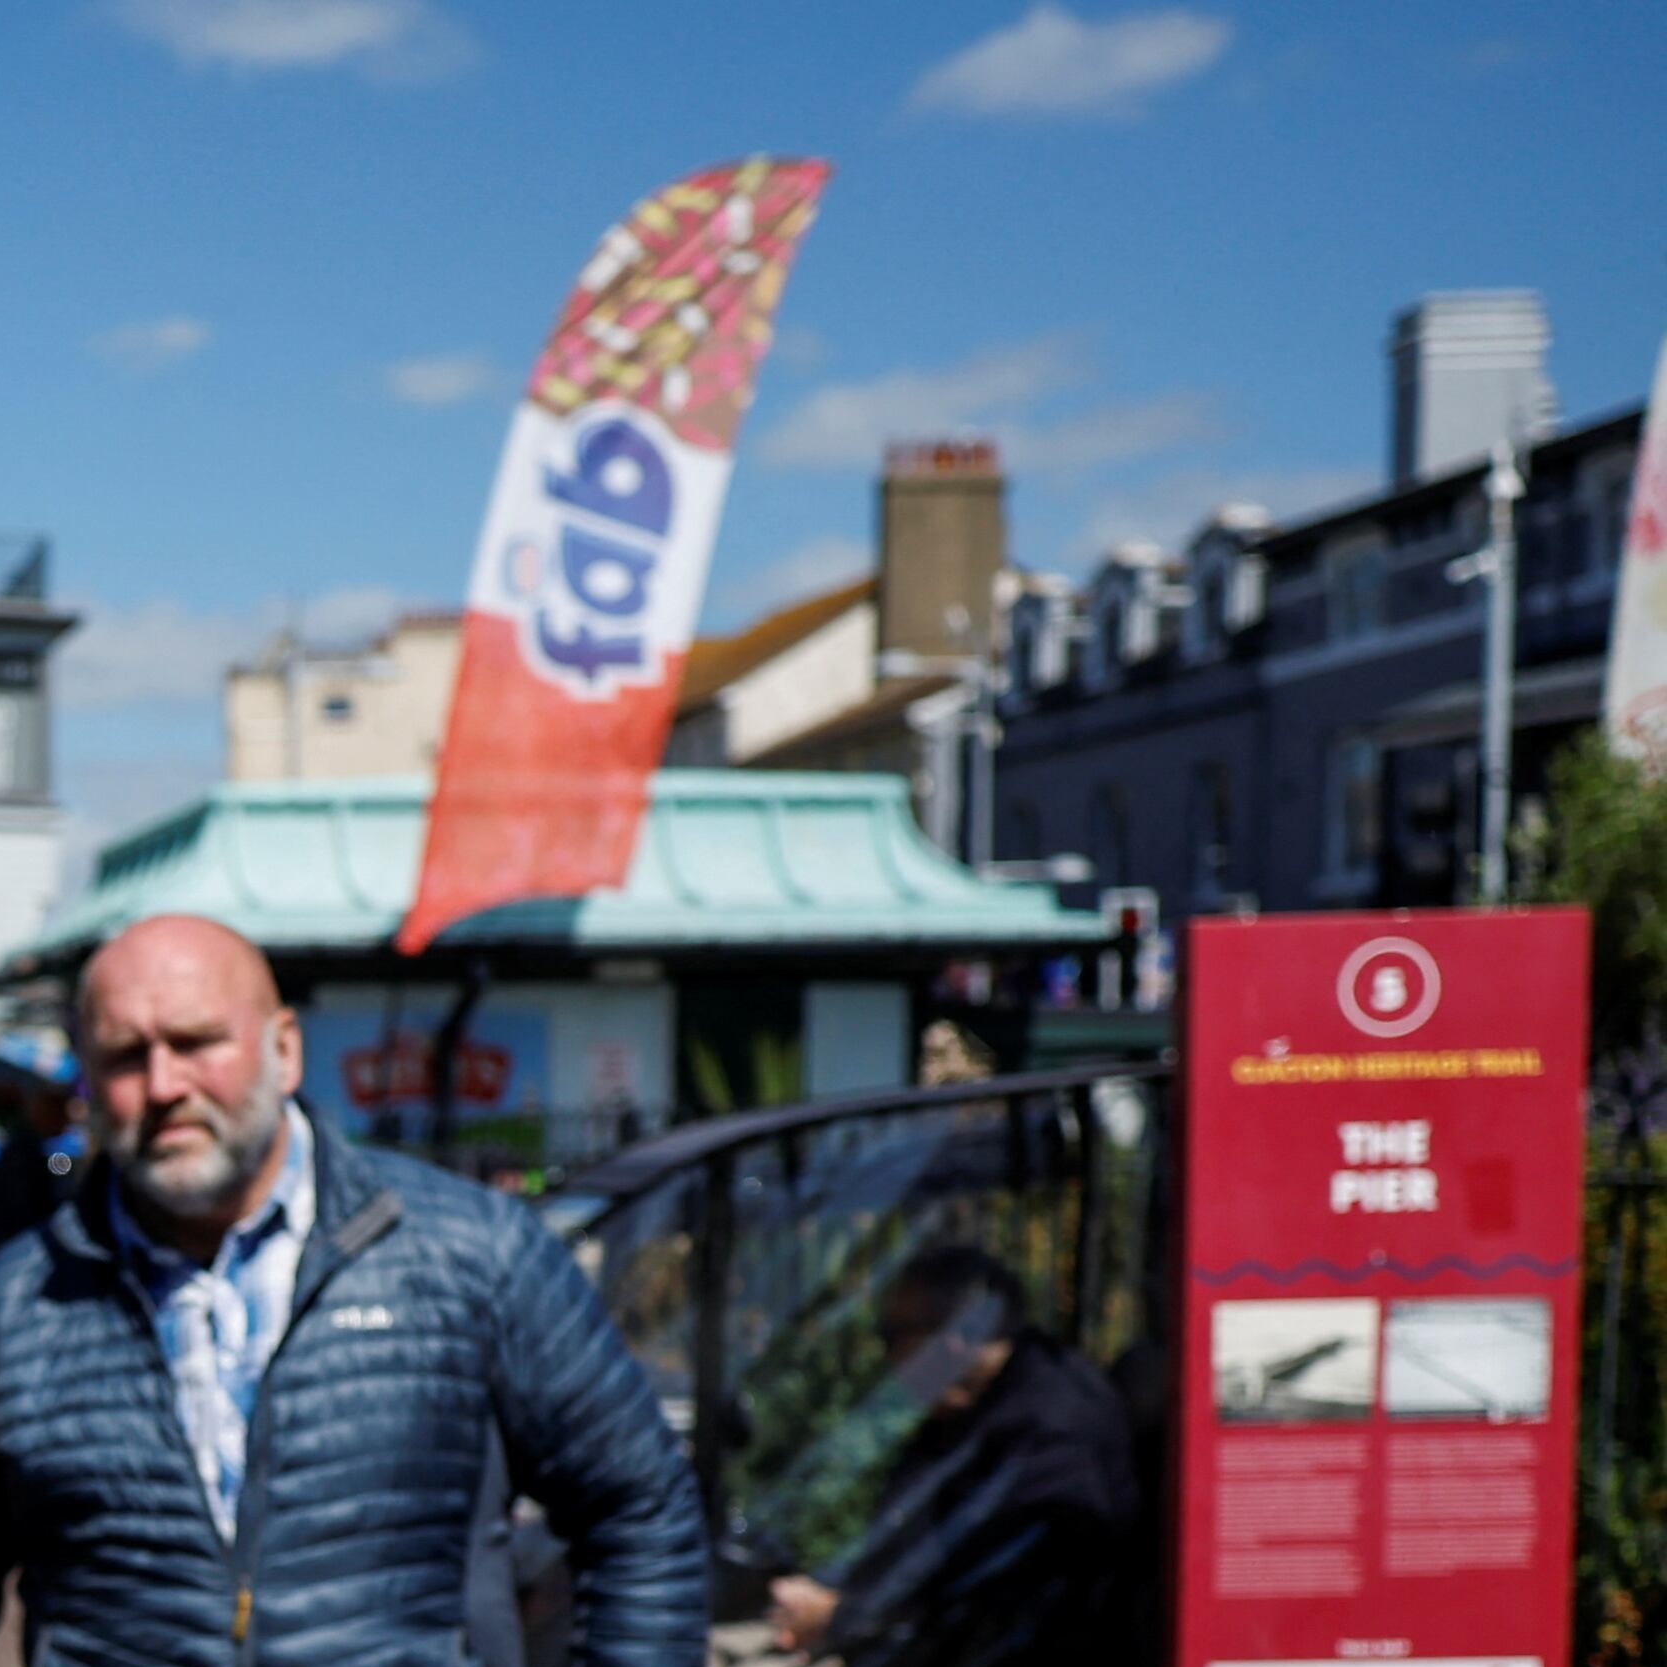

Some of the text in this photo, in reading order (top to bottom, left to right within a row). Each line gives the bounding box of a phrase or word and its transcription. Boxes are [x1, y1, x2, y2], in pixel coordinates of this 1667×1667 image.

[536, 419, 675, 682] fab
[1338, 1119, 1430, 1165] THE
[1329, 1168, 1439, 1214] PIER
